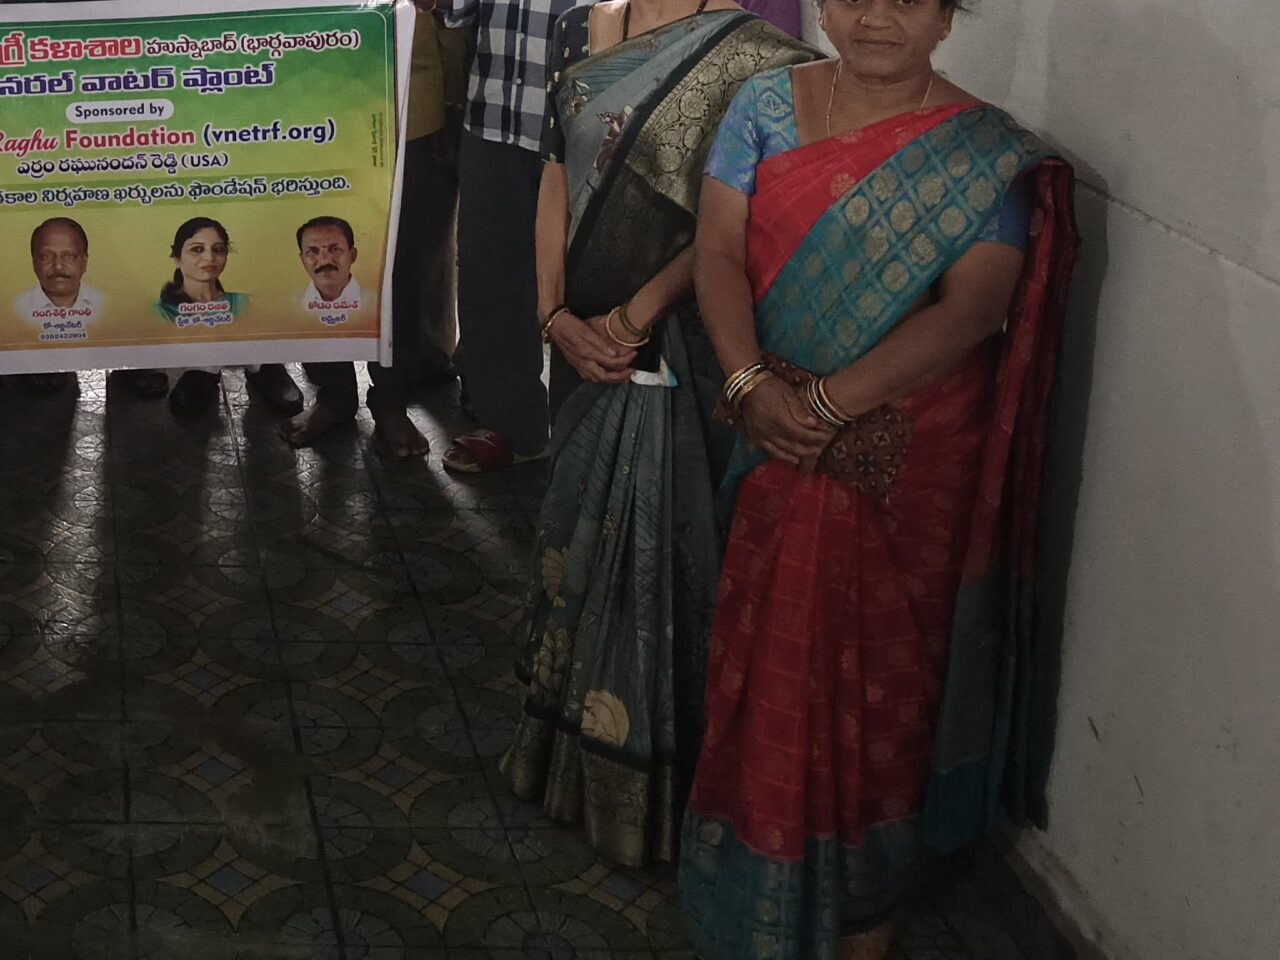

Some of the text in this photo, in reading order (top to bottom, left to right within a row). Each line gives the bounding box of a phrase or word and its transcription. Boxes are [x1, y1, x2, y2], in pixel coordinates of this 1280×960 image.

[29, 37, 142, 60] కళాశాల
[146, 32, 237, 59] హుస్నాబాద్
[81, 67, 174, 93] వాటర్
[183, 63, 275, 93] ప్లాంట్
[75, 104, 165, 120] Sponsored by
[65, 127, 195, 149] Foundation
[203, 119, 336, 147] (vnetrf.org)
[17, 159, 55, 178] ఎర్రం
[58, 154, 148, 175] రఘునందన్
[150, 153, 178, 174] రెడ్డి
[42, 187, 110, 207] నిర్వహణ
